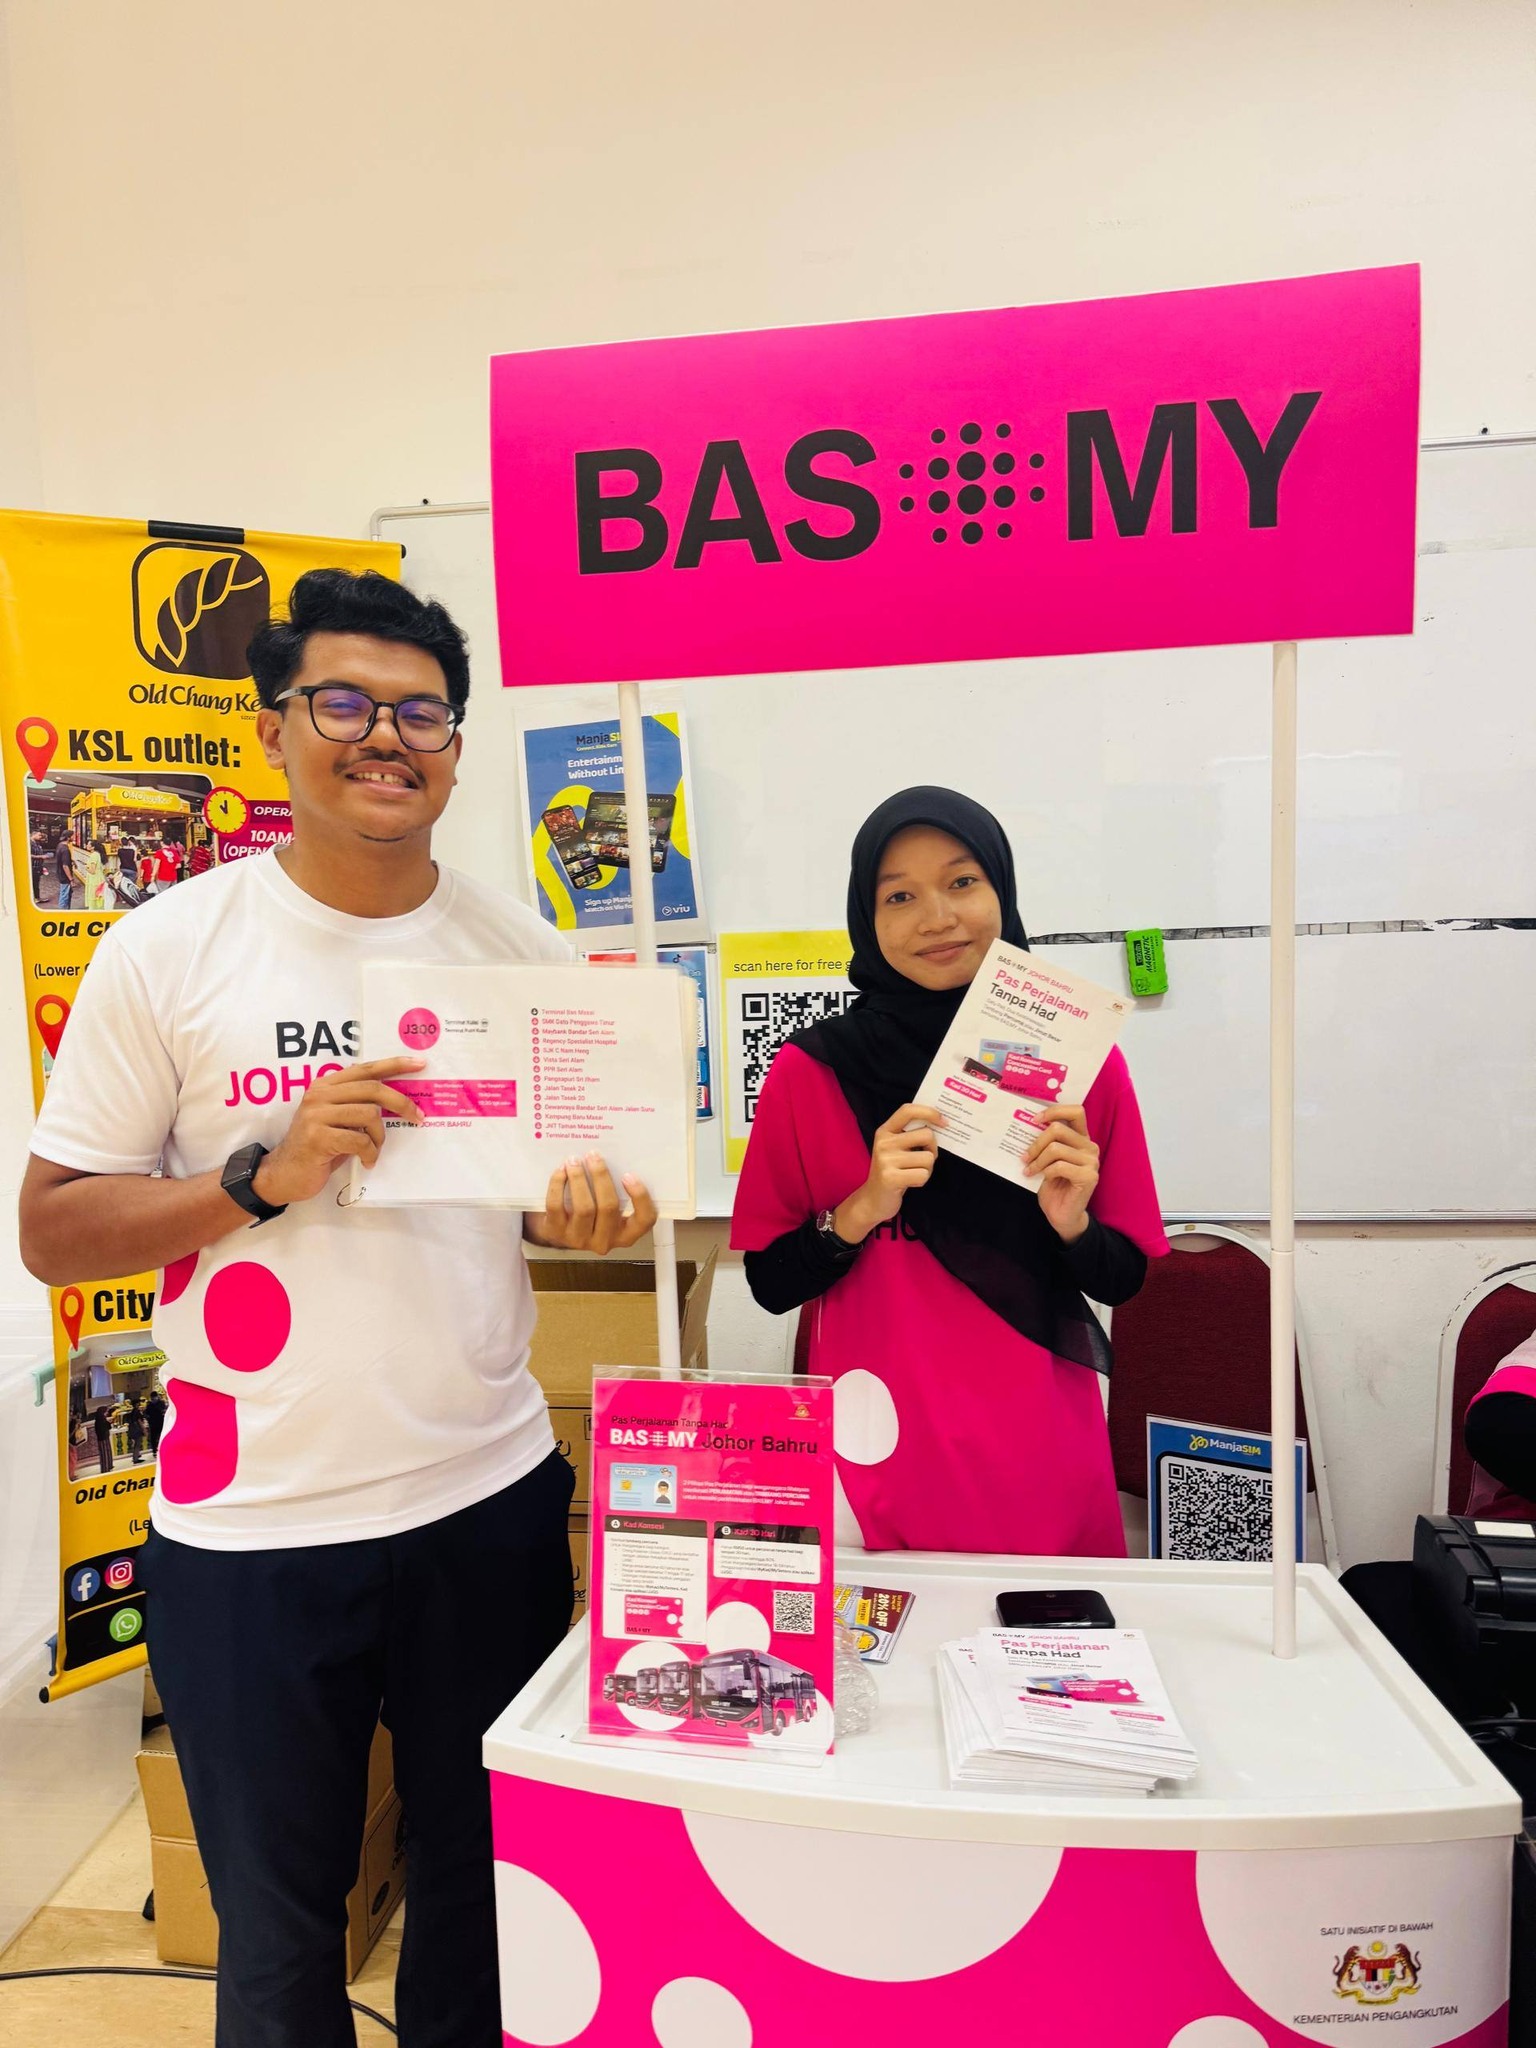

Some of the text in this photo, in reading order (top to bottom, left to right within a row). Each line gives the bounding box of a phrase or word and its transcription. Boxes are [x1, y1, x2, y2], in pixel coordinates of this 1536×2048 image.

[574, 391, 1323, 576] BAS MY
[128, 684, 261, 714] Old Chang Ke
[576, 732, 621, 745] ManjaSI
[68, 728, 241, 768] KSL outlet:
[568, 755, 623, 768] Entertainm
[568, 768, 608, 779] Without
[612, 894, 633, 904] Manj
[672, 904, 691, 913] viu
[41, 921, 110, 937] Old C
[34, 963, 81, 980] (Lower
[733, 962, 762, 972] scan
[765, 960, 793, 971] here
[796, 959, 814, 970] for
[817, 958, 843, 970] free
[997, 955, 1012, 966] BAS
[1016, 964, 1028, 973] MY
[989, 982, 1028, 1009] Tanpa
[1028, 1001, 1058, 1022] Had
[995, 969, 1020, 989] Pas
[1021, 981, 1089, 1020] Perjalanan
[403, 1024, 437, 1035] J300
[275, 1020, 361, 1059] BAS
[92, 1289, 155, 1322] City
[611, 1416, 628, 1425] Pas
[630, 1416, 679, 1428] Perjalanan
[680, 1418, 708, 1430] Tanpa
[610, 1428, 818, 1455] BAS MY Johor Bahru
[1209, 1438, 1262, 1456] ManjaSIM
[75, 1484, 107, 1505] Old
[129, 1519, 151, 1536] (Le
[876, 1611, 888, 1627] OFF
[1000, 1639, 1110, 1651] Pas Perjalanan
[1001, 1646, 1081, 1658] Tanpa Had
[1320, 1922, 1434, 1936] SATU INISIATIF DI BAWAH
[1293, 2005, 1458, 2024] KEMENTERIAN PENGANGKUTAN
